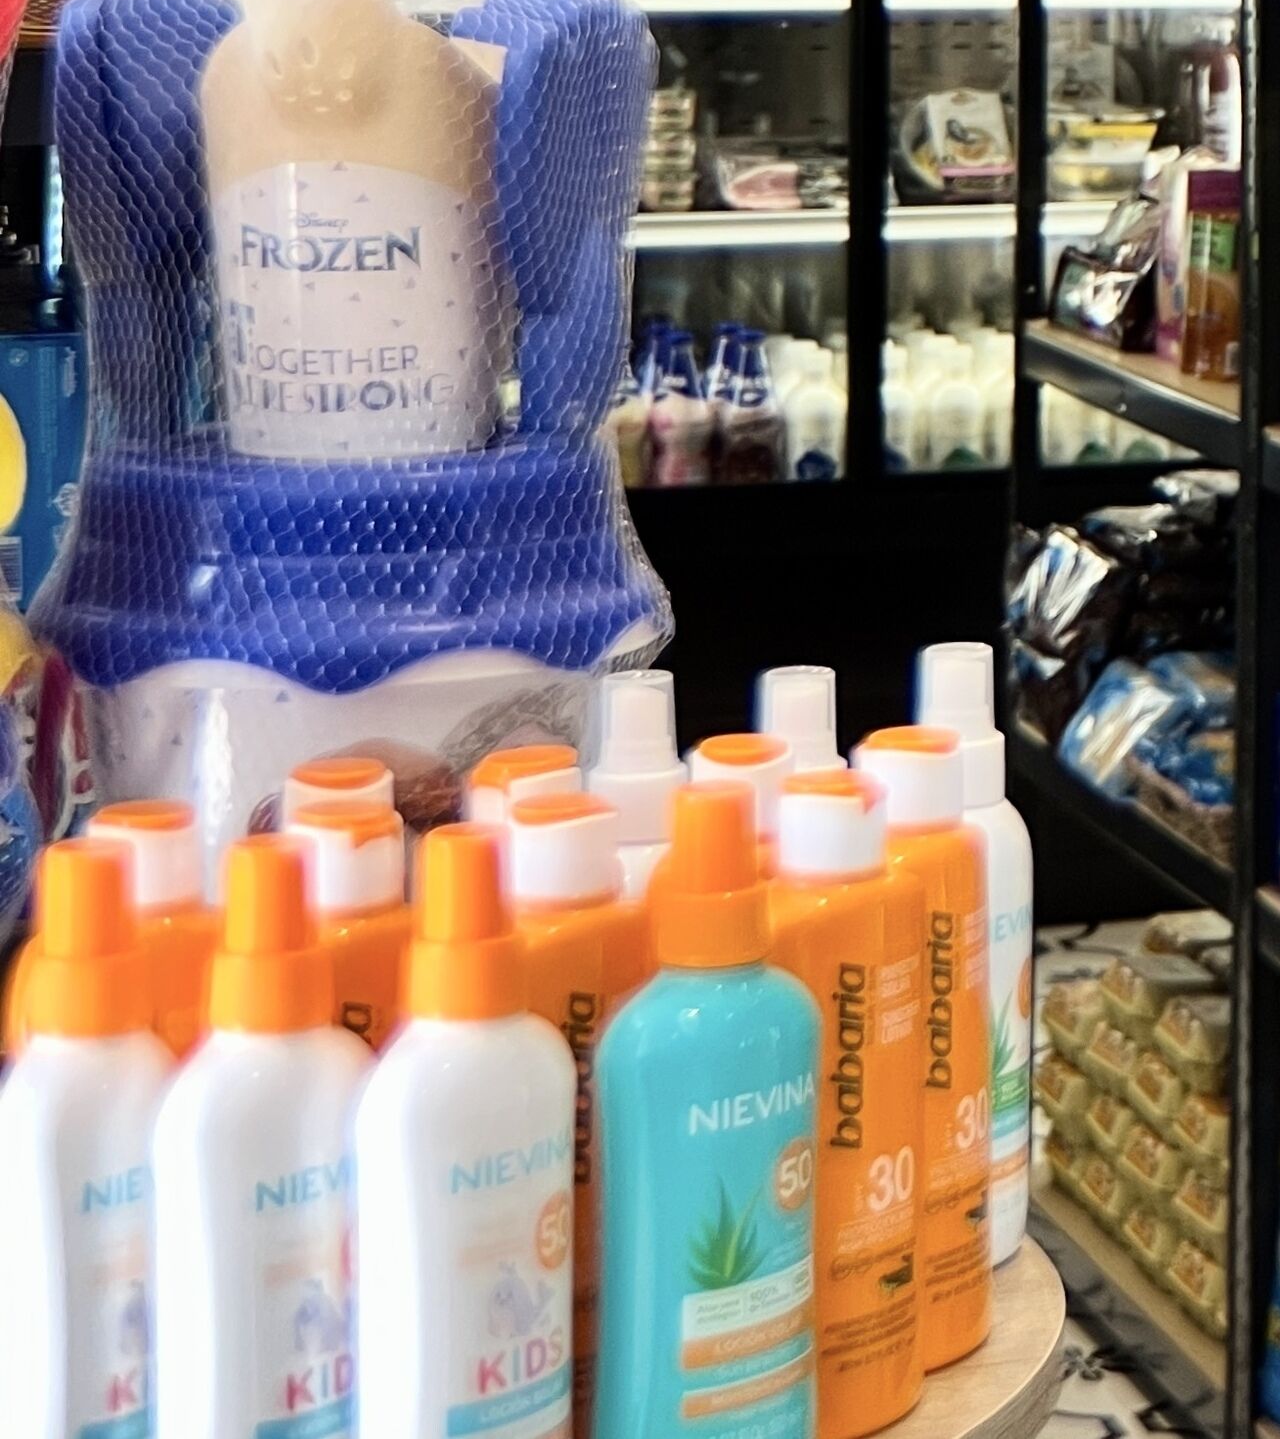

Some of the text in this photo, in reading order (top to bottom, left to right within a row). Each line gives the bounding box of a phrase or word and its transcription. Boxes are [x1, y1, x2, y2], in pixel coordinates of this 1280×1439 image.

[240, 224, 422, 273] FROZEN
[924, 910, 954, 1090] babaria
[829, 962, 866, 1150] babaria
[688, 1071, 817, 1137] NIEVINA
[955, 1087, 989, 1150] 30
[777, 1148, 815, 1202] 50
[867, 1145, 916, 1212] 30
[477, 1325, 564, 1396] KIDS
